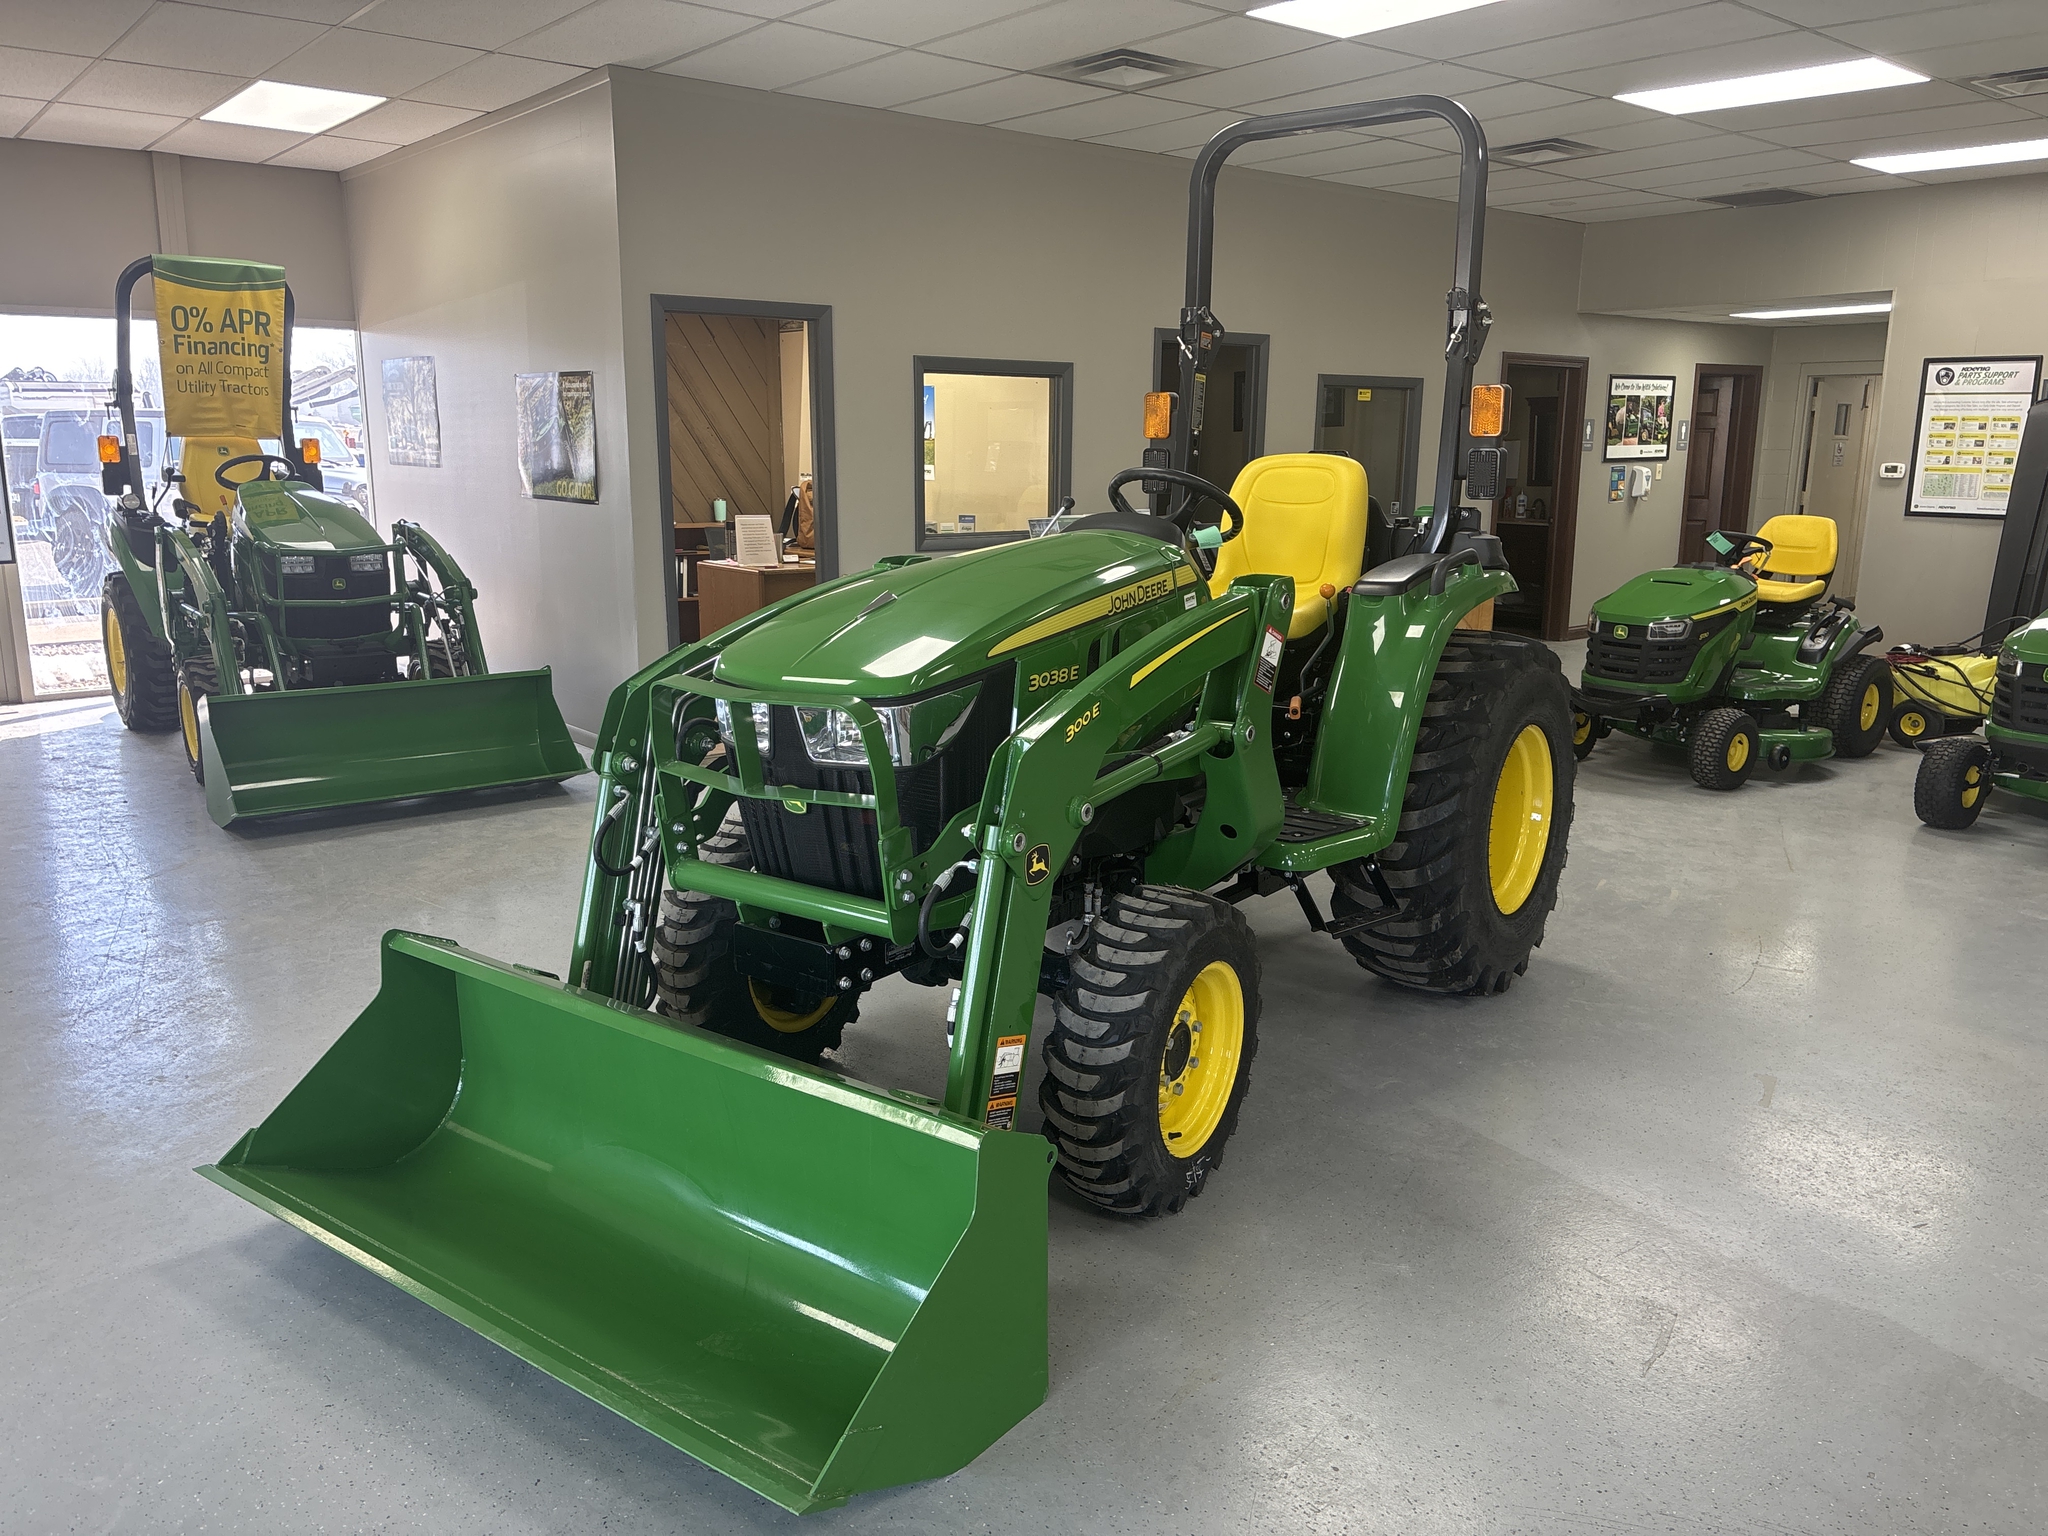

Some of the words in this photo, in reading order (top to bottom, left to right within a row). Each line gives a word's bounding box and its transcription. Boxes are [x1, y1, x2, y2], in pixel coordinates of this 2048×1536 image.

[170, 305, 214, 333] 0%
[219, 308, 271, 337] APR
[176, 363, 194, 375] on
[197, 361, 213, 375] All
[215, 361, 270, 380] Compact
[1957, 371, 1982, 379] PARTS
[1982, 371, 2020, 379] SUPPORT
[176, 379, 217, 397] Utility
[219, 379, 270, 396] Tractors
[1961, 378, 2006, 386] PROGRAMS
[556, 480, 567, 496] GO
[1107, 591, 1137, 615] JOHN
[1136, 579, 1168, 605] DEERE
